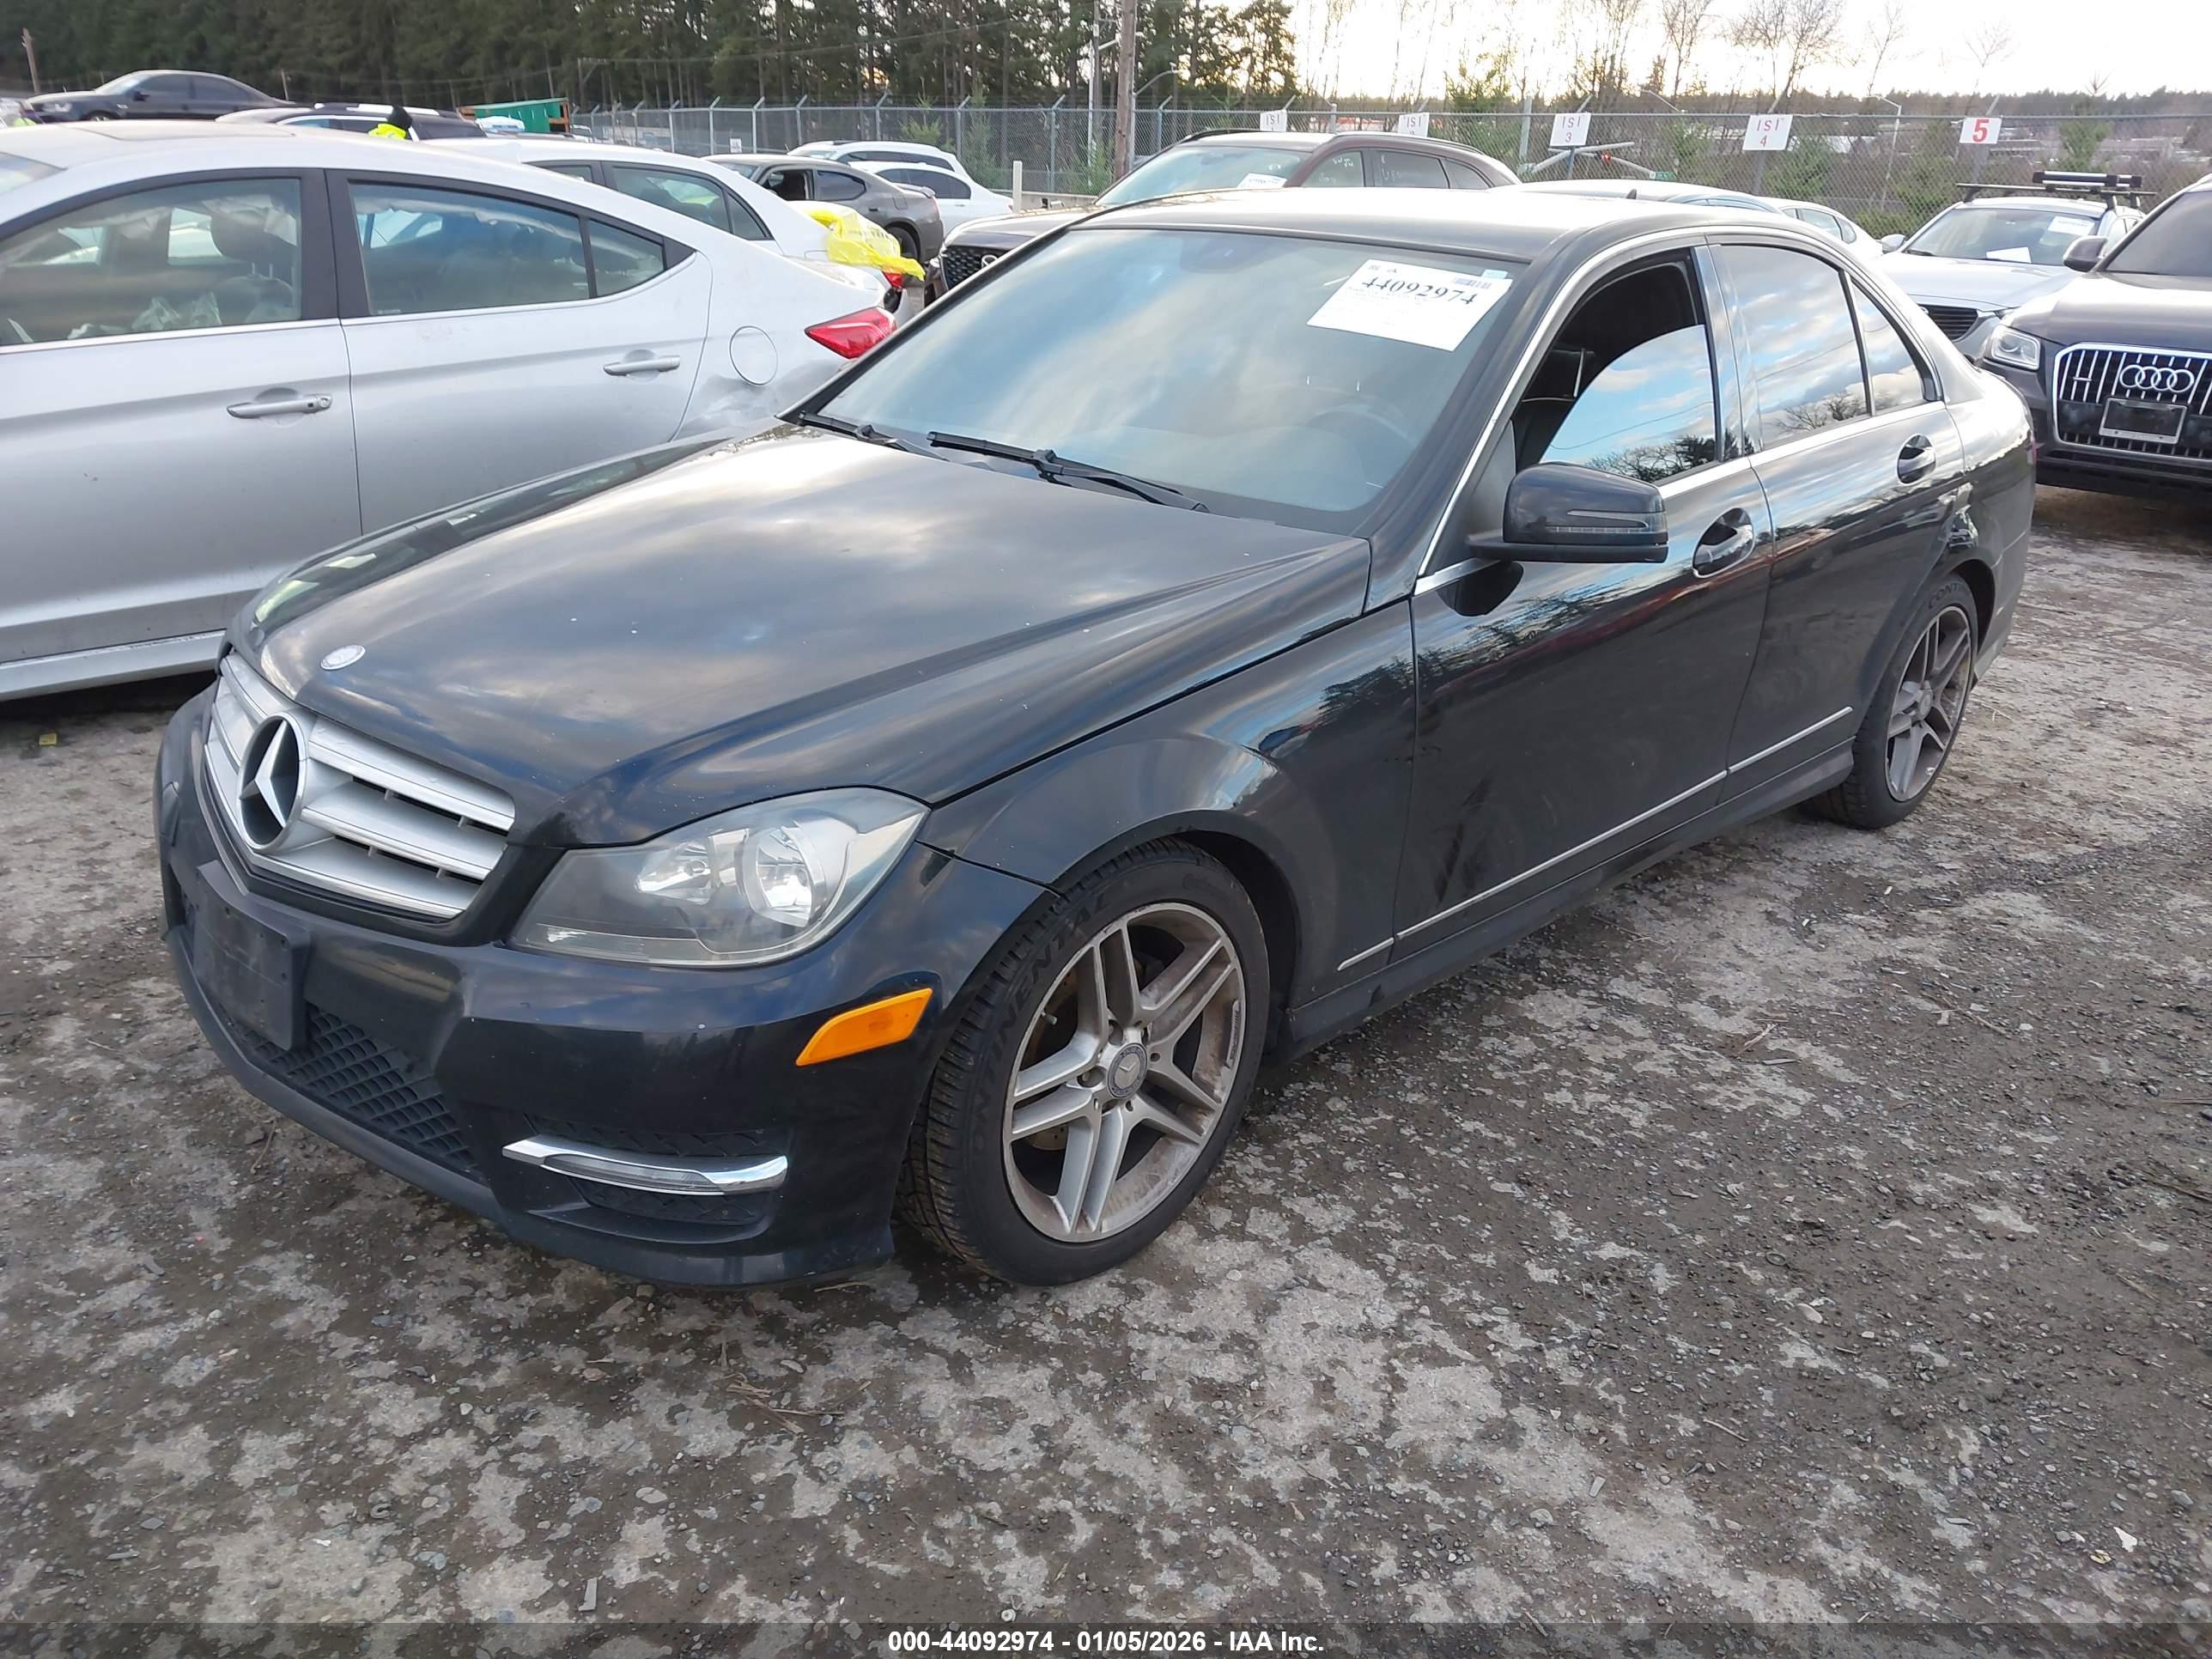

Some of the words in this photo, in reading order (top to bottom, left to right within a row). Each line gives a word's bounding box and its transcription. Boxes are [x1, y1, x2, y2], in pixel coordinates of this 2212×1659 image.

[1565, 131, 1572, 143] 3
[1972, 118, 1990, 143] 5
[1760, 135, 1767, 147] 4
[1361, 276, 1478, 305] 44092974
